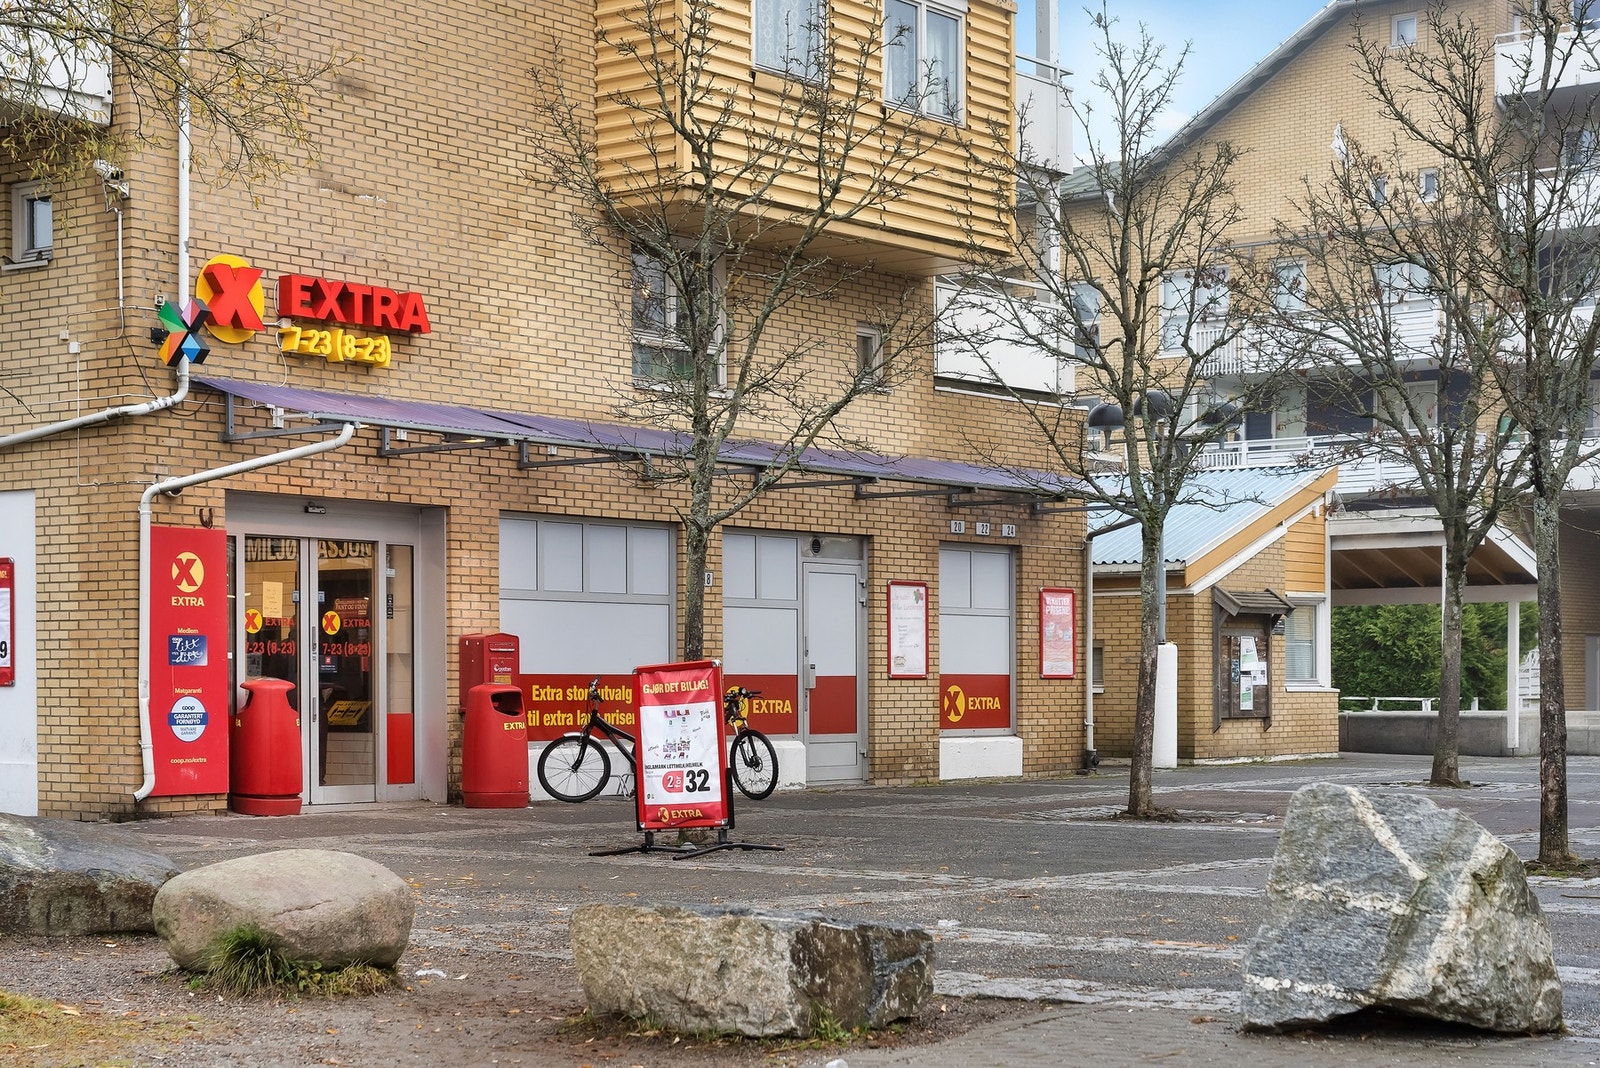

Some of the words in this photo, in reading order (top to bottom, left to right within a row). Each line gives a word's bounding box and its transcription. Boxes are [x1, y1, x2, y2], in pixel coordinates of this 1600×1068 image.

[279, 274, 431, 334] EXTRA
[954, 521, 962, 532] 20
[981, 523, 989, 534] 22
[1006, 525, 1014, 536] 24
[171, 596, 205, 607] EXTRA
[265, 617, 295, 626] EXTRA
[343, 619, 371, 628] EXTRA
[267, 640, 296, 656] (8-23)
[322, 643, 342, 655] 7-23
[532, 684, 563, 701] Extra
[643, 683, 664, 694] GJØR
[664, 682, 679, 693] DET
[752, 699, 793, 714] EXTRA
[968, 697, 1001, 710] EXTRA
[527, 710, 540, 726] til
[543, 710, 574, 726] extra
[170, 757, 207, 765] coop.no/extra
[667, 775, 675, 788] 2
[685, 768, 711, 793] 32
[671, 809, 703, 819] EXTRA
